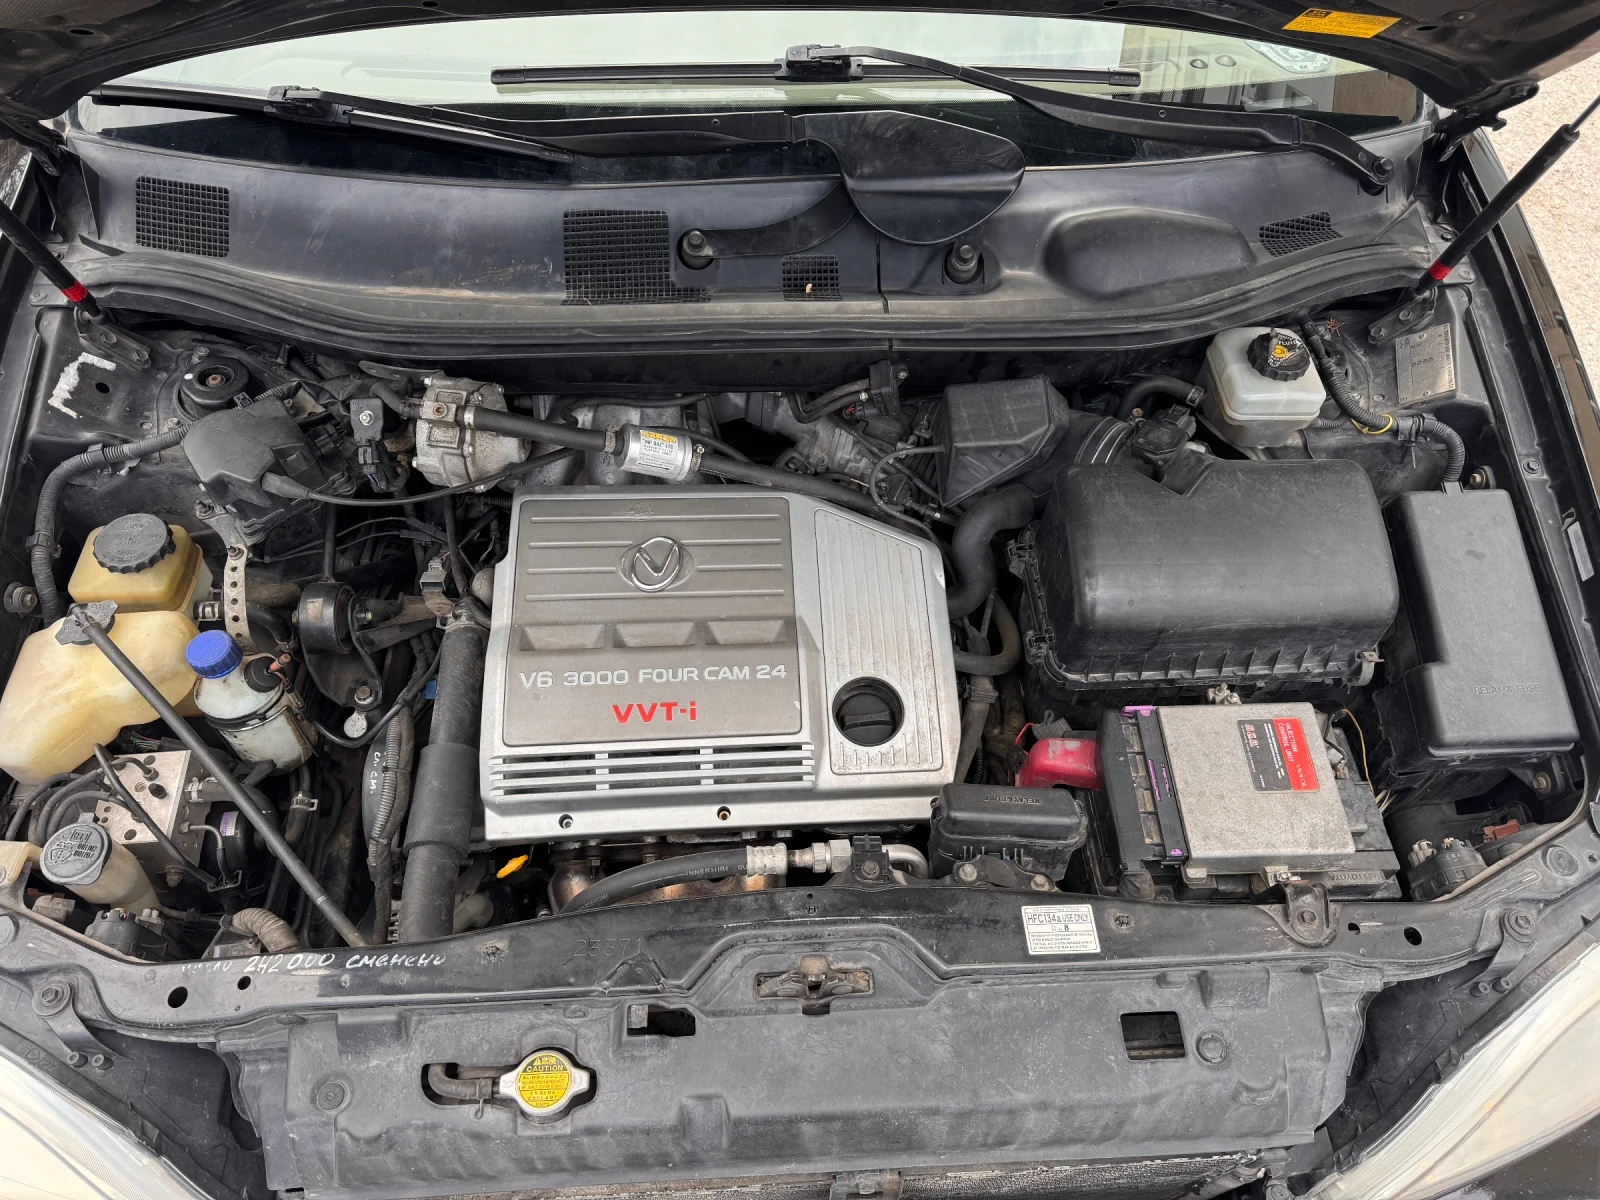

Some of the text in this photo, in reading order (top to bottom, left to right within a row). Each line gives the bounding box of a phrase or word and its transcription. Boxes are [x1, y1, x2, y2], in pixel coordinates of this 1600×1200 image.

[520, 664, 787, 688] V6 3000 FOUR CAM 24
[1474, 684, 1541, 695] RELAY & FUSE
[612, 701, 697, 724] VVT-i
[1285, 723, 1298, 752] INJECTION
[574, 938, 641, 957] 23371
[526, 1064, 563, 1073] CAUTION
